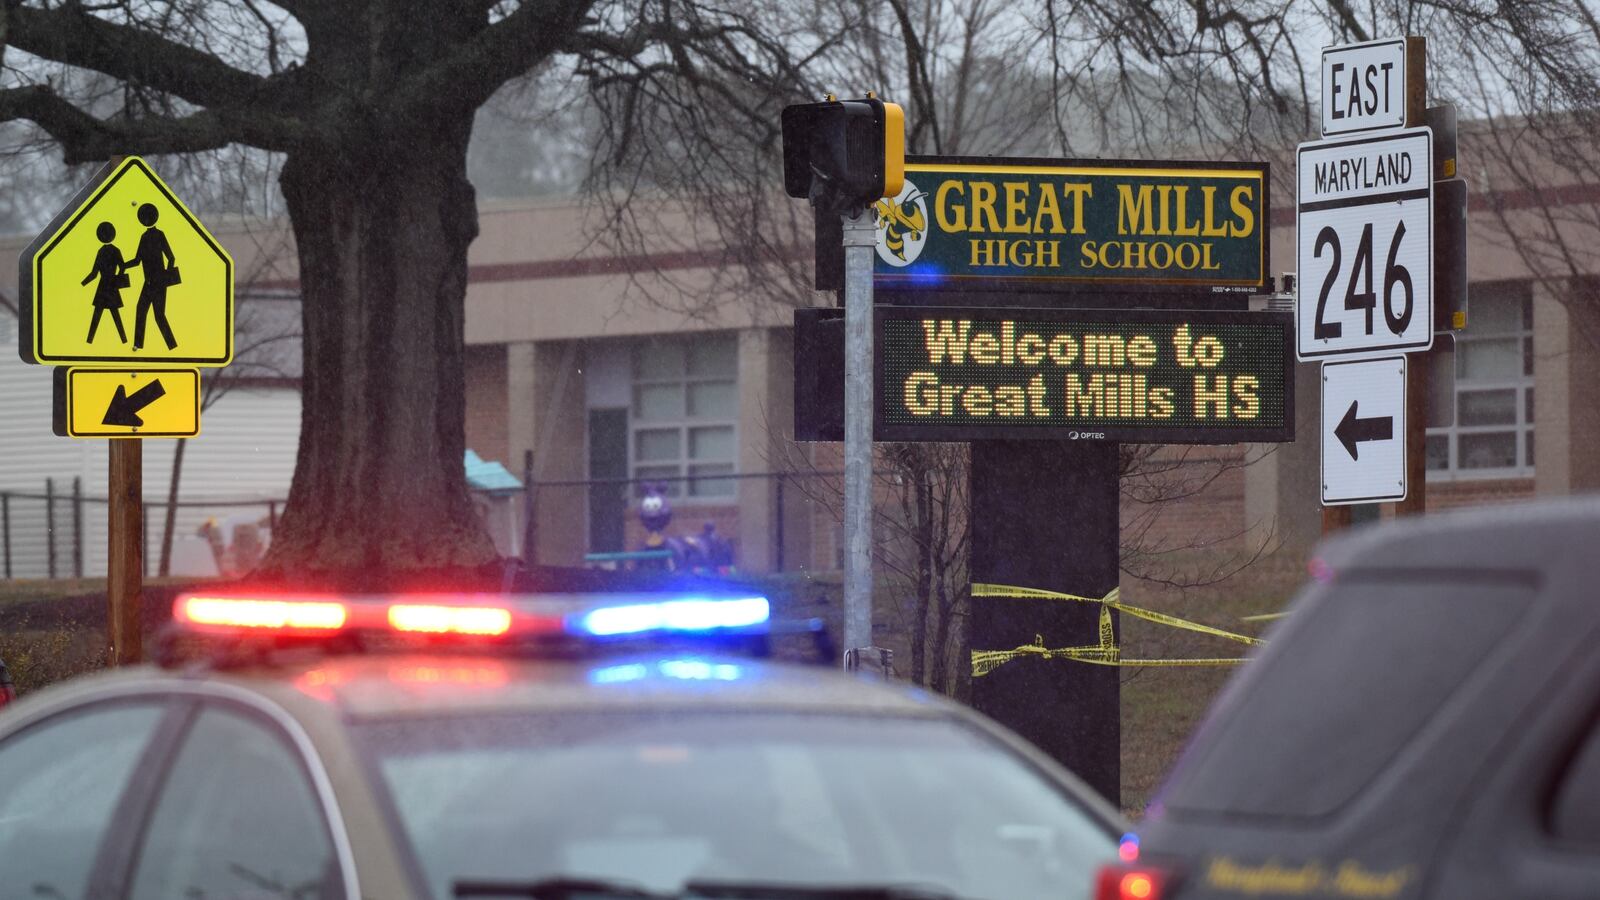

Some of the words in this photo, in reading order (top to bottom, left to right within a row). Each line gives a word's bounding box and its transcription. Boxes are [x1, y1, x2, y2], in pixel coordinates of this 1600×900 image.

[1331, 62, 1393, 119] EAST
[1315, 152, 1411, 194] MARYLAND
[935, 179, 1093, 234] GREAT
[1117, 184, 1254, 238] MILLS
[969, 239, 1061, 268] HIGH
[1080, 241, 1220, 270] SCHOOL
[1313, 219, 1413, 340] 246
[922, 320, 1157, 366] Welcome
[1173, 323, 1225, 368] to
[904, 372, 1050, 416] Great
[1065, 374, 1175, 418] Mills
[1193, 375, 1261, 419] HS
